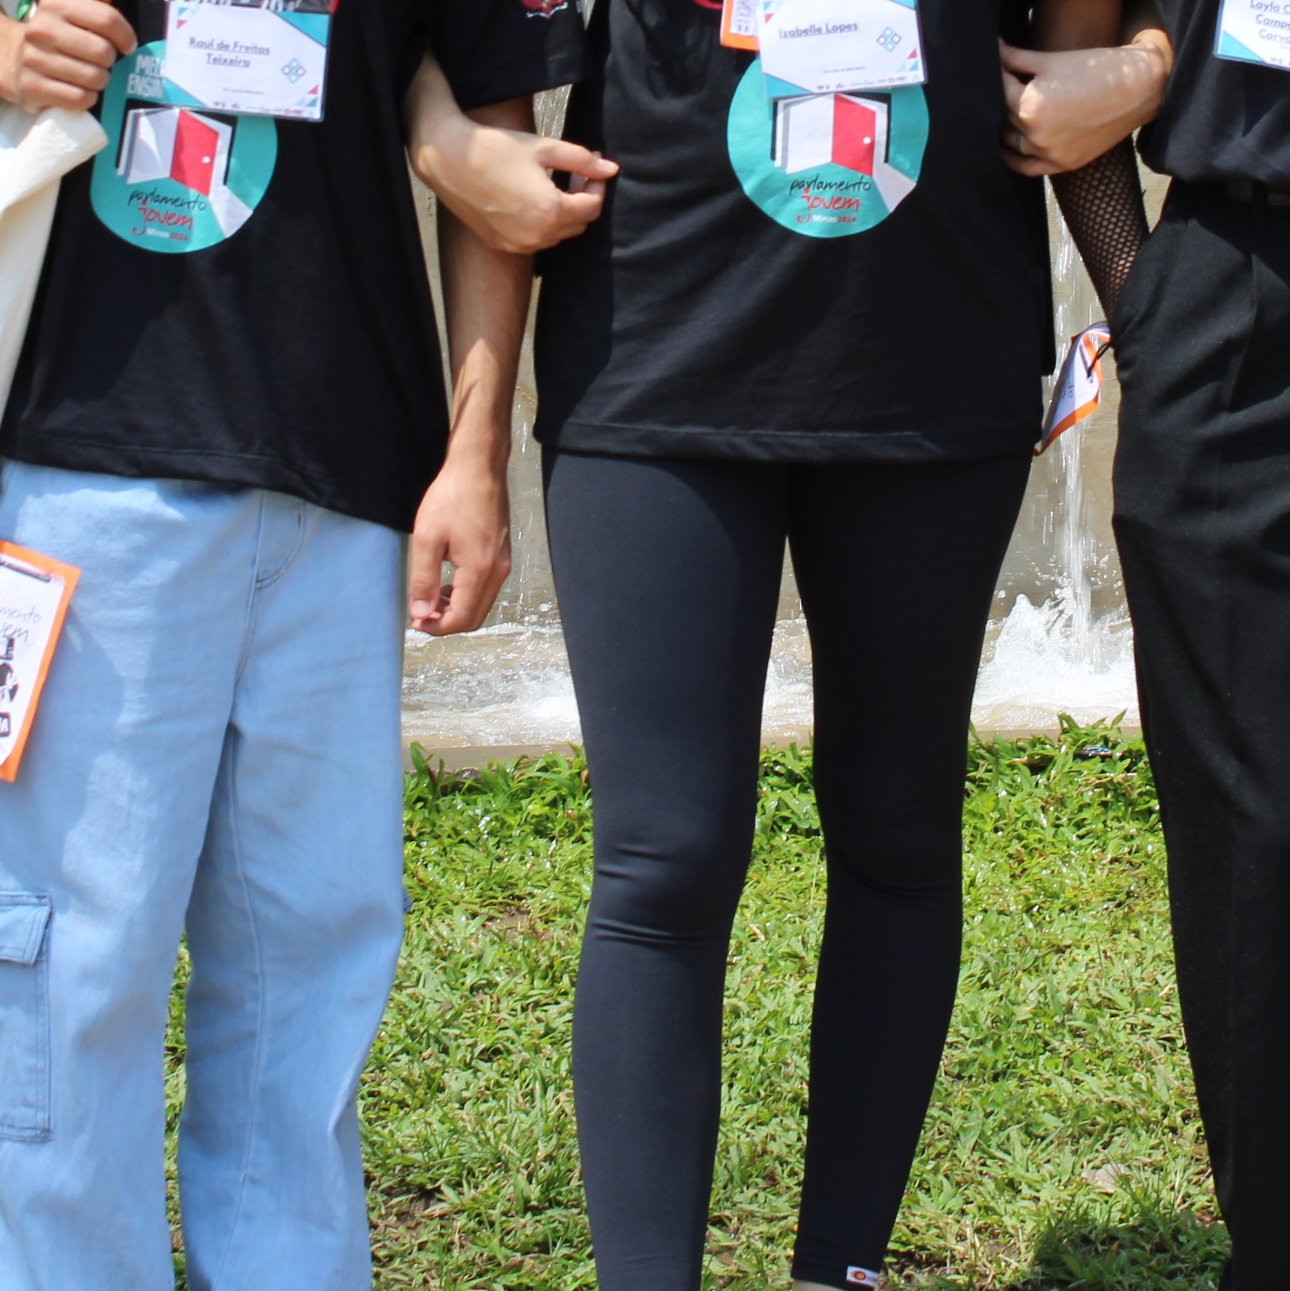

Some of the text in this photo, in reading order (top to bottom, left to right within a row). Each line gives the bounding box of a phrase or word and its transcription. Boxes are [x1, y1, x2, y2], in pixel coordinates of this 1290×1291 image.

[779, 22, 858, 39] Izabelle Lopes
[189, 36, 271, 57] Raul de Freitas
[206, 53, 250, 68] Teixeira
[789, 173, 871, 196] parlamento
[128, 187, 206, 210] parlamento
[796, 187, 860, 224] jovem
[132, 199, 193, 237] jovem
